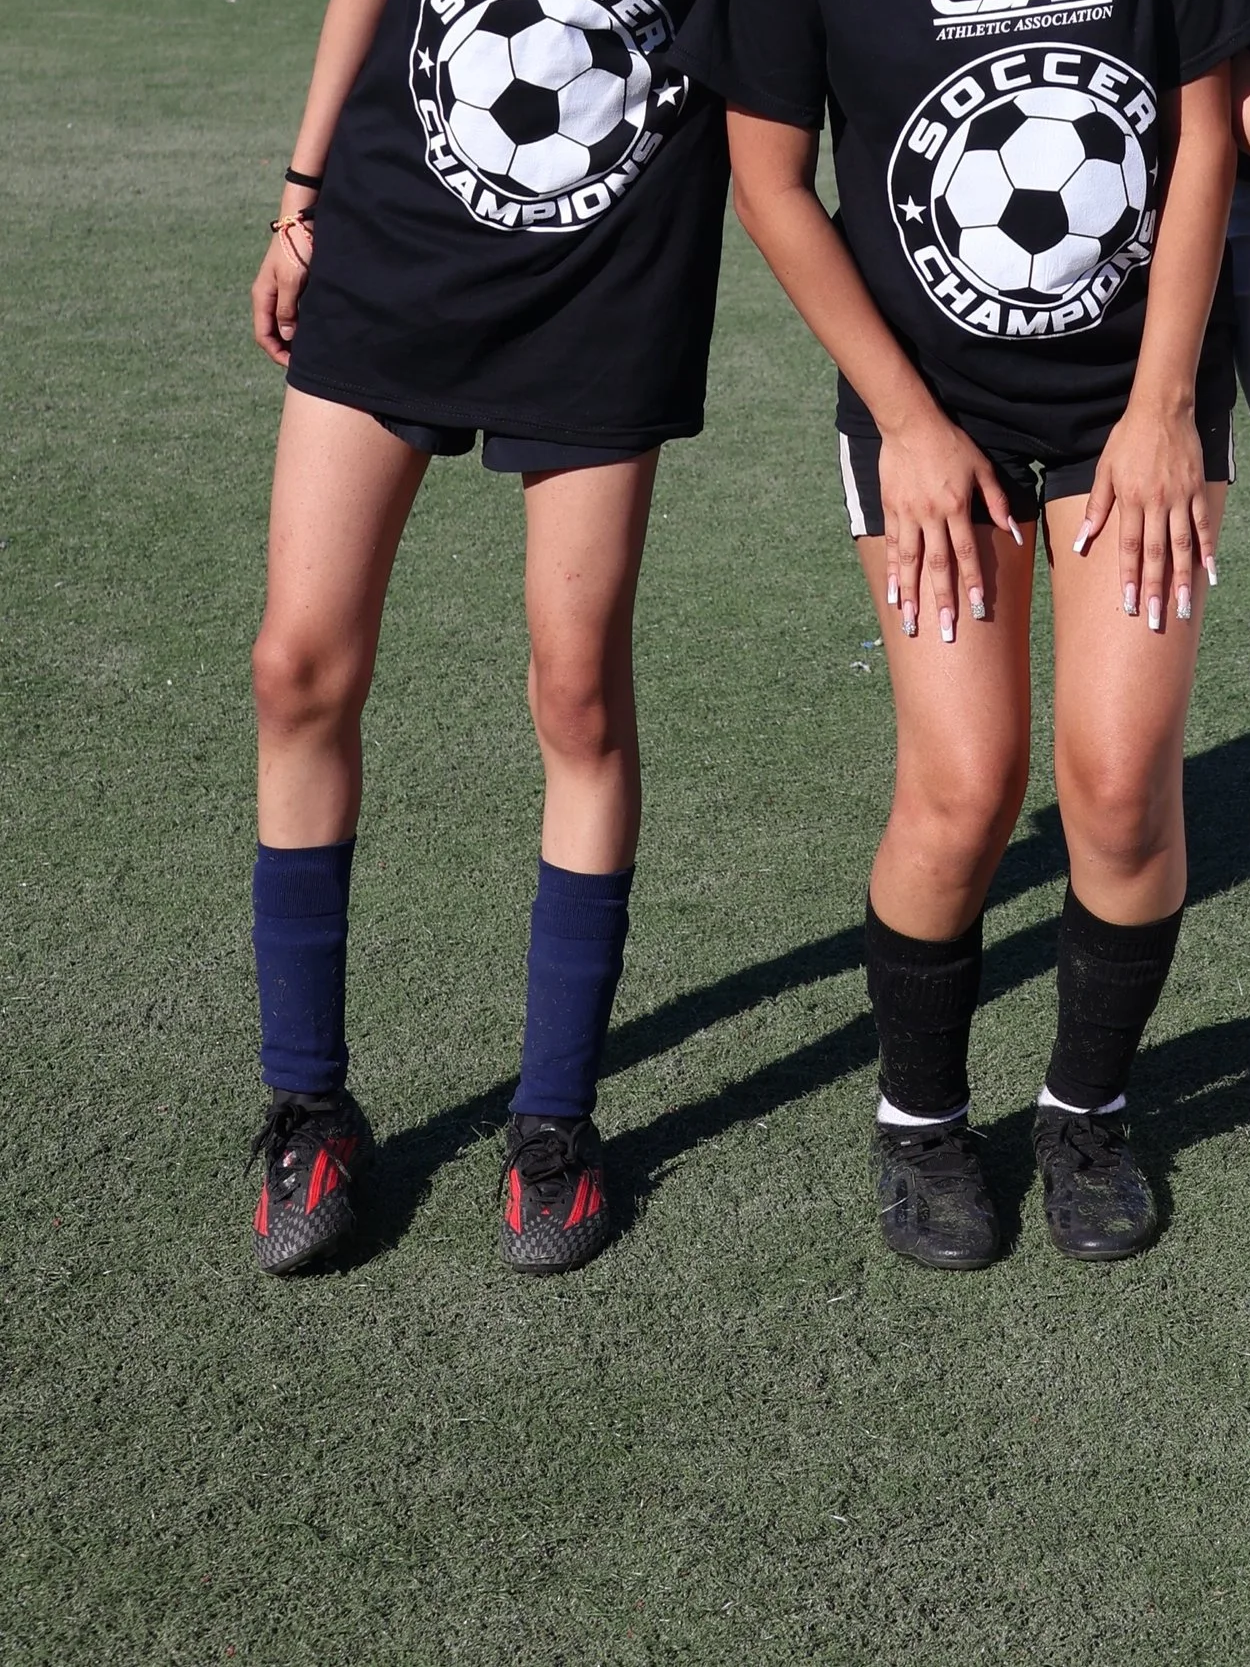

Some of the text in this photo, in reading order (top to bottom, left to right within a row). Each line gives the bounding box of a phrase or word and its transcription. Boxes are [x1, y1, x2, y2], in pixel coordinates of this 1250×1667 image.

[936, 6, 1113, 41] ATHLETIC ASSOCIATION
[418, 99, 663, 227] CHAMPIONS
[908, 52, 1157, 162] SOCCER
[913, 209, 1157, 336] CHAMPIONS
